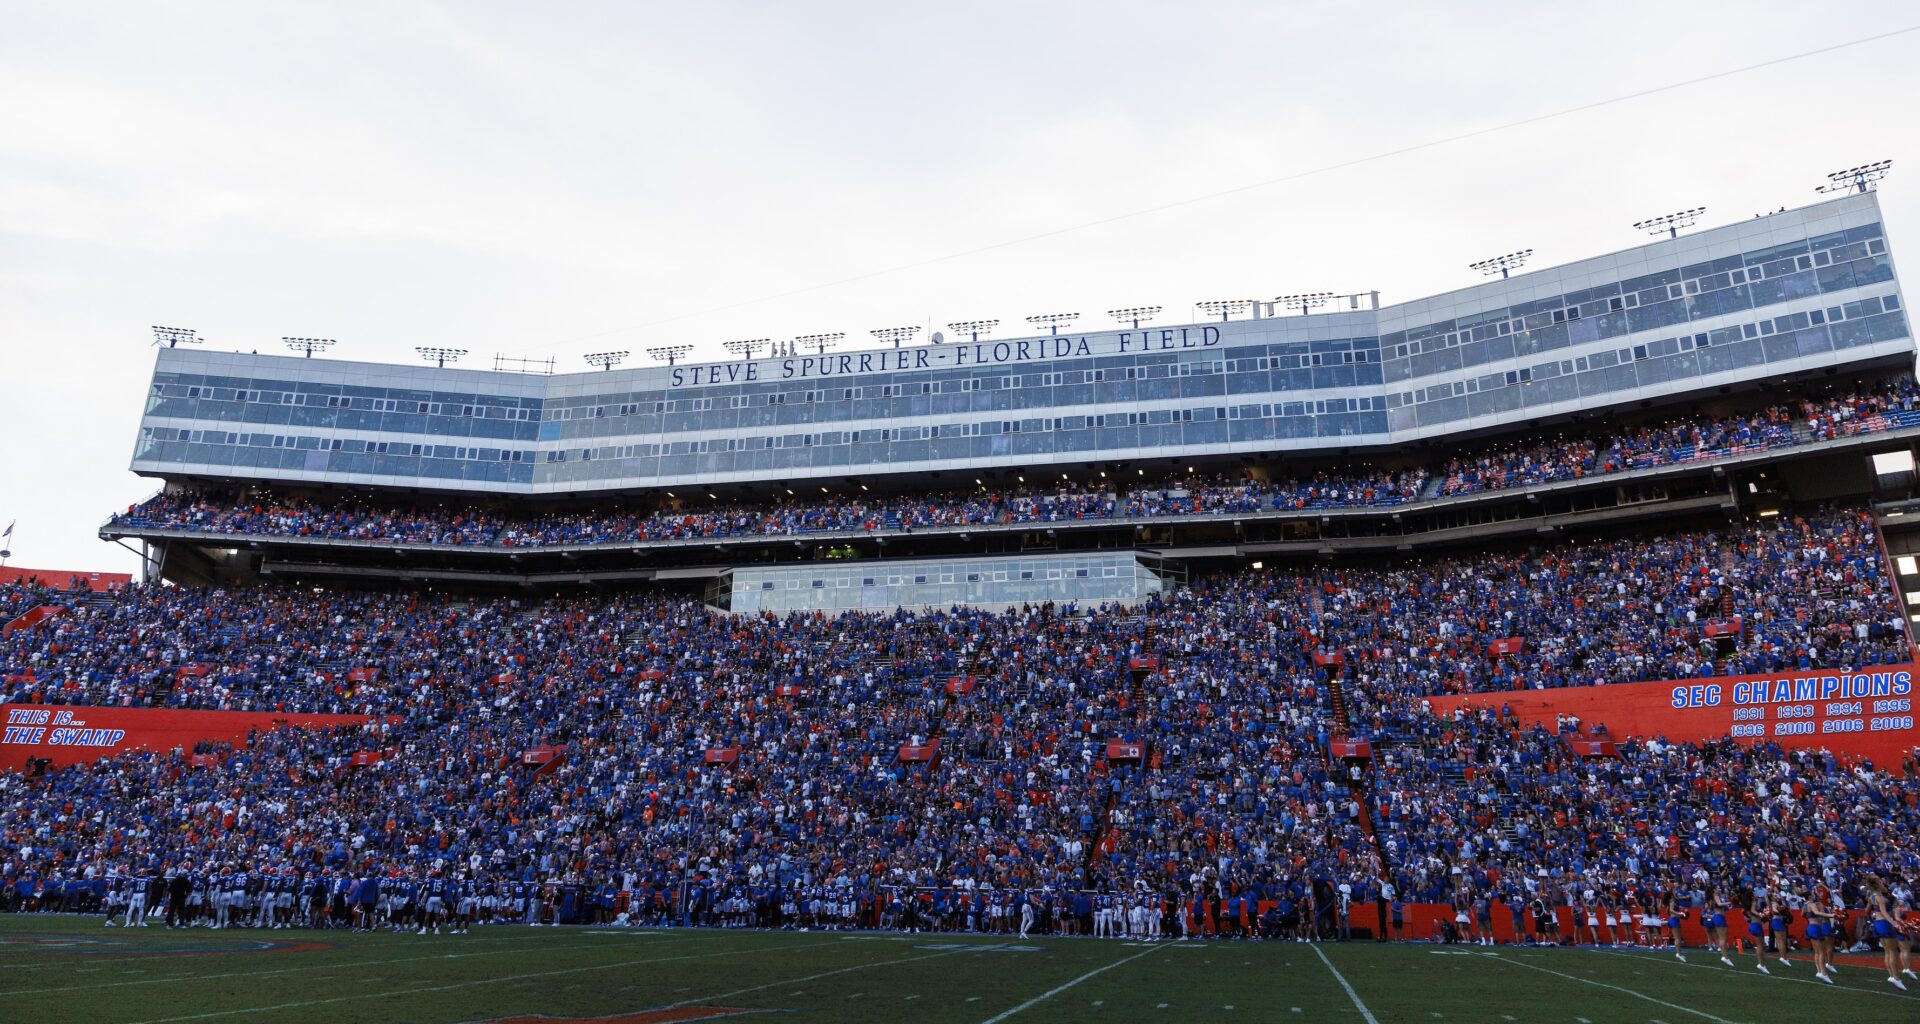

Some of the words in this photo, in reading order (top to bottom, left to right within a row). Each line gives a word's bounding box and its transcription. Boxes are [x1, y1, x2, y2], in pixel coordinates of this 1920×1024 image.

[672, 361, 760, 388] STEVE
[782, 336, 1092, 380] SPURRIER-FLORIDA
[1119, 325, 1223, 354] FIELD
[1671, 684, 1721, 709] SEC
[1732, 671, 1912, 705] CHAMPIONS
[7, 708, 51, 725] THIS
[52, 710, 86, 726] IS...
[1733, 706, 1765, 721] 1991
[1777, 704, 1814, 719] 1993
[1826, 701, 1862, 717] 1994
[1873, 699, 1911, 714] 1995
[1, 726, 46, 745] THE
[48, 727, 125, 746] SWAMP
[1731, 723, 1765, 738] 1996
[1775, 721, 1816, 736] 2000
[1822, 718, 1864, 734] 2006
[1870, 715, 1914, 731] 2008
[235, 877, 247, 887] 96
[433, 882, 443, 893] 15
